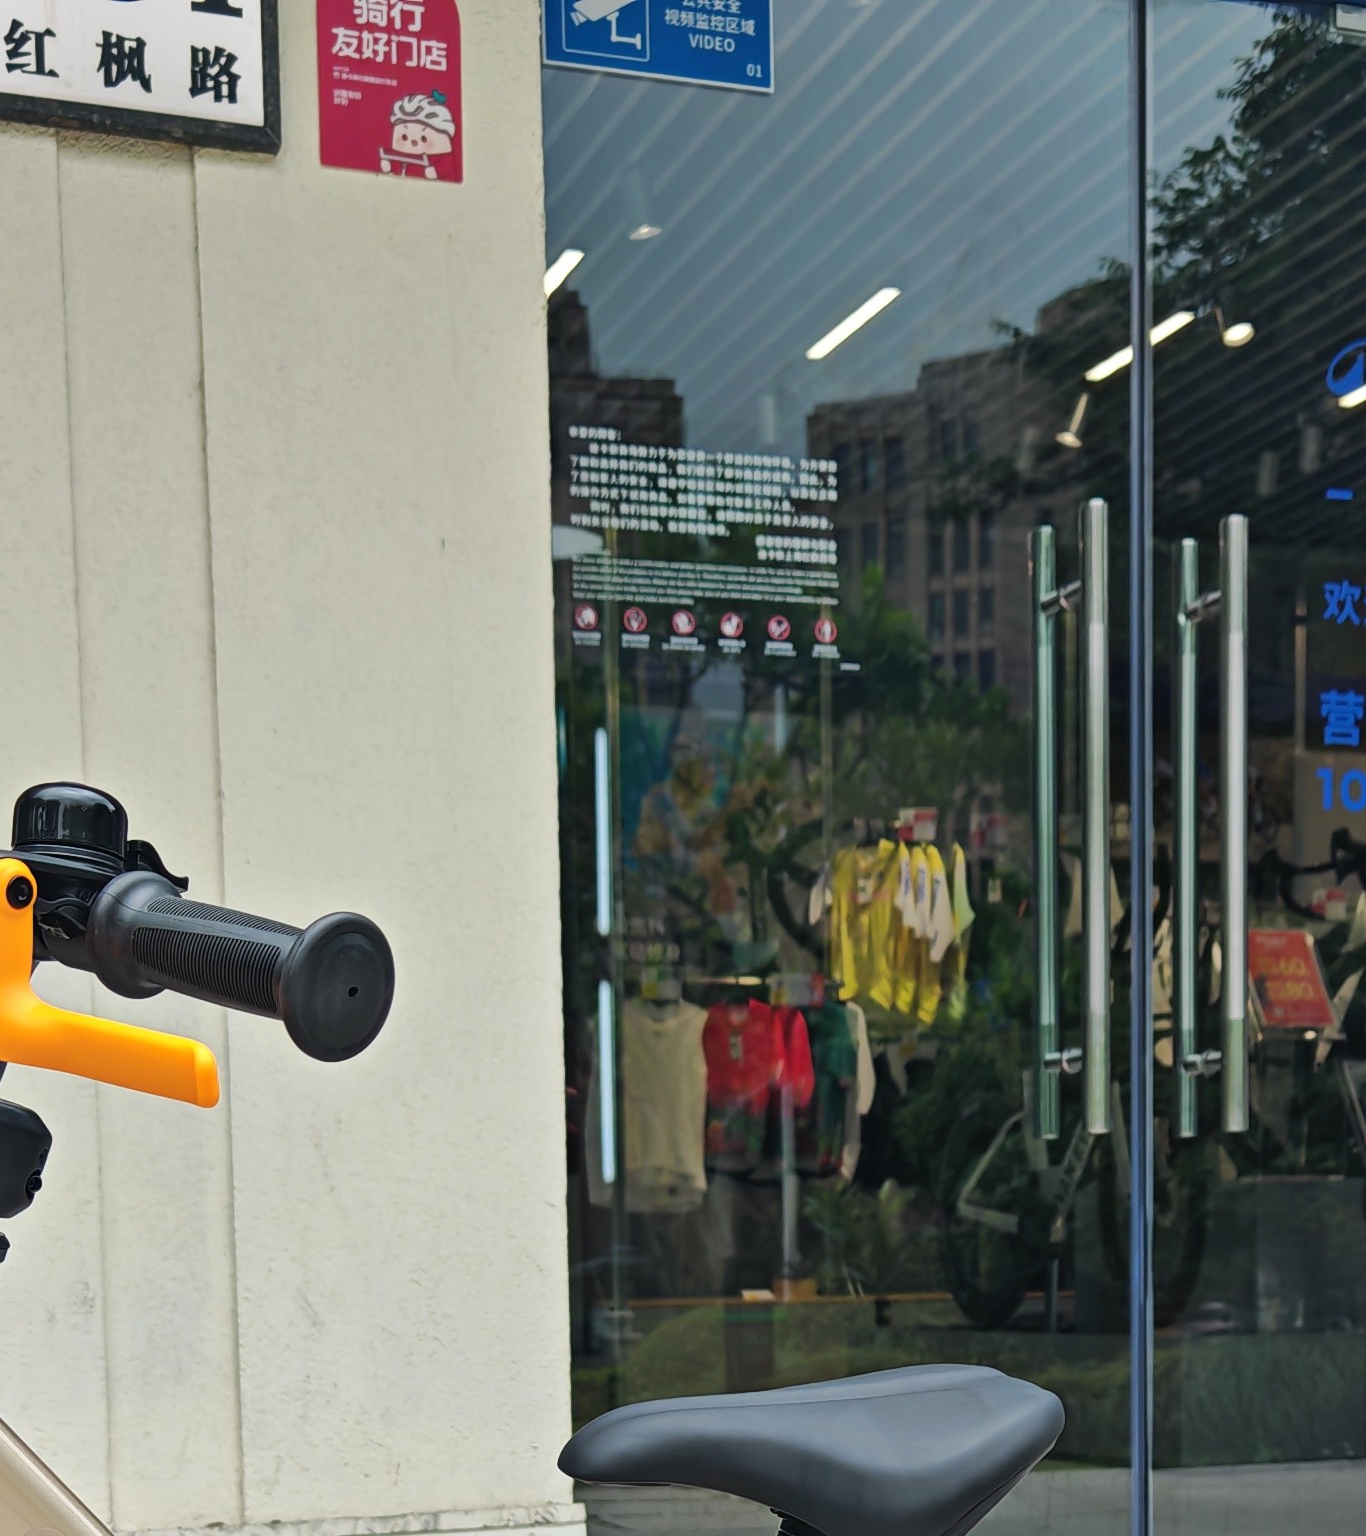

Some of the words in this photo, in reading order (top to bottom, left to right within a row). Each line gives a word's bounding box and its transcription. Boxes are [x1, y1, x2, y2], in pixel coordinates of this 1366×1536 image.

[353, 0, 425, 32] 骑行
[665, 8, 756, 36] 视频监控区域
[331, 27, 447, 71] 友好门店
[688, 33, 735, 53] VIDEO
[4, 18, 241, 104] 红枫路
[746, 63, 763, 78] 01
